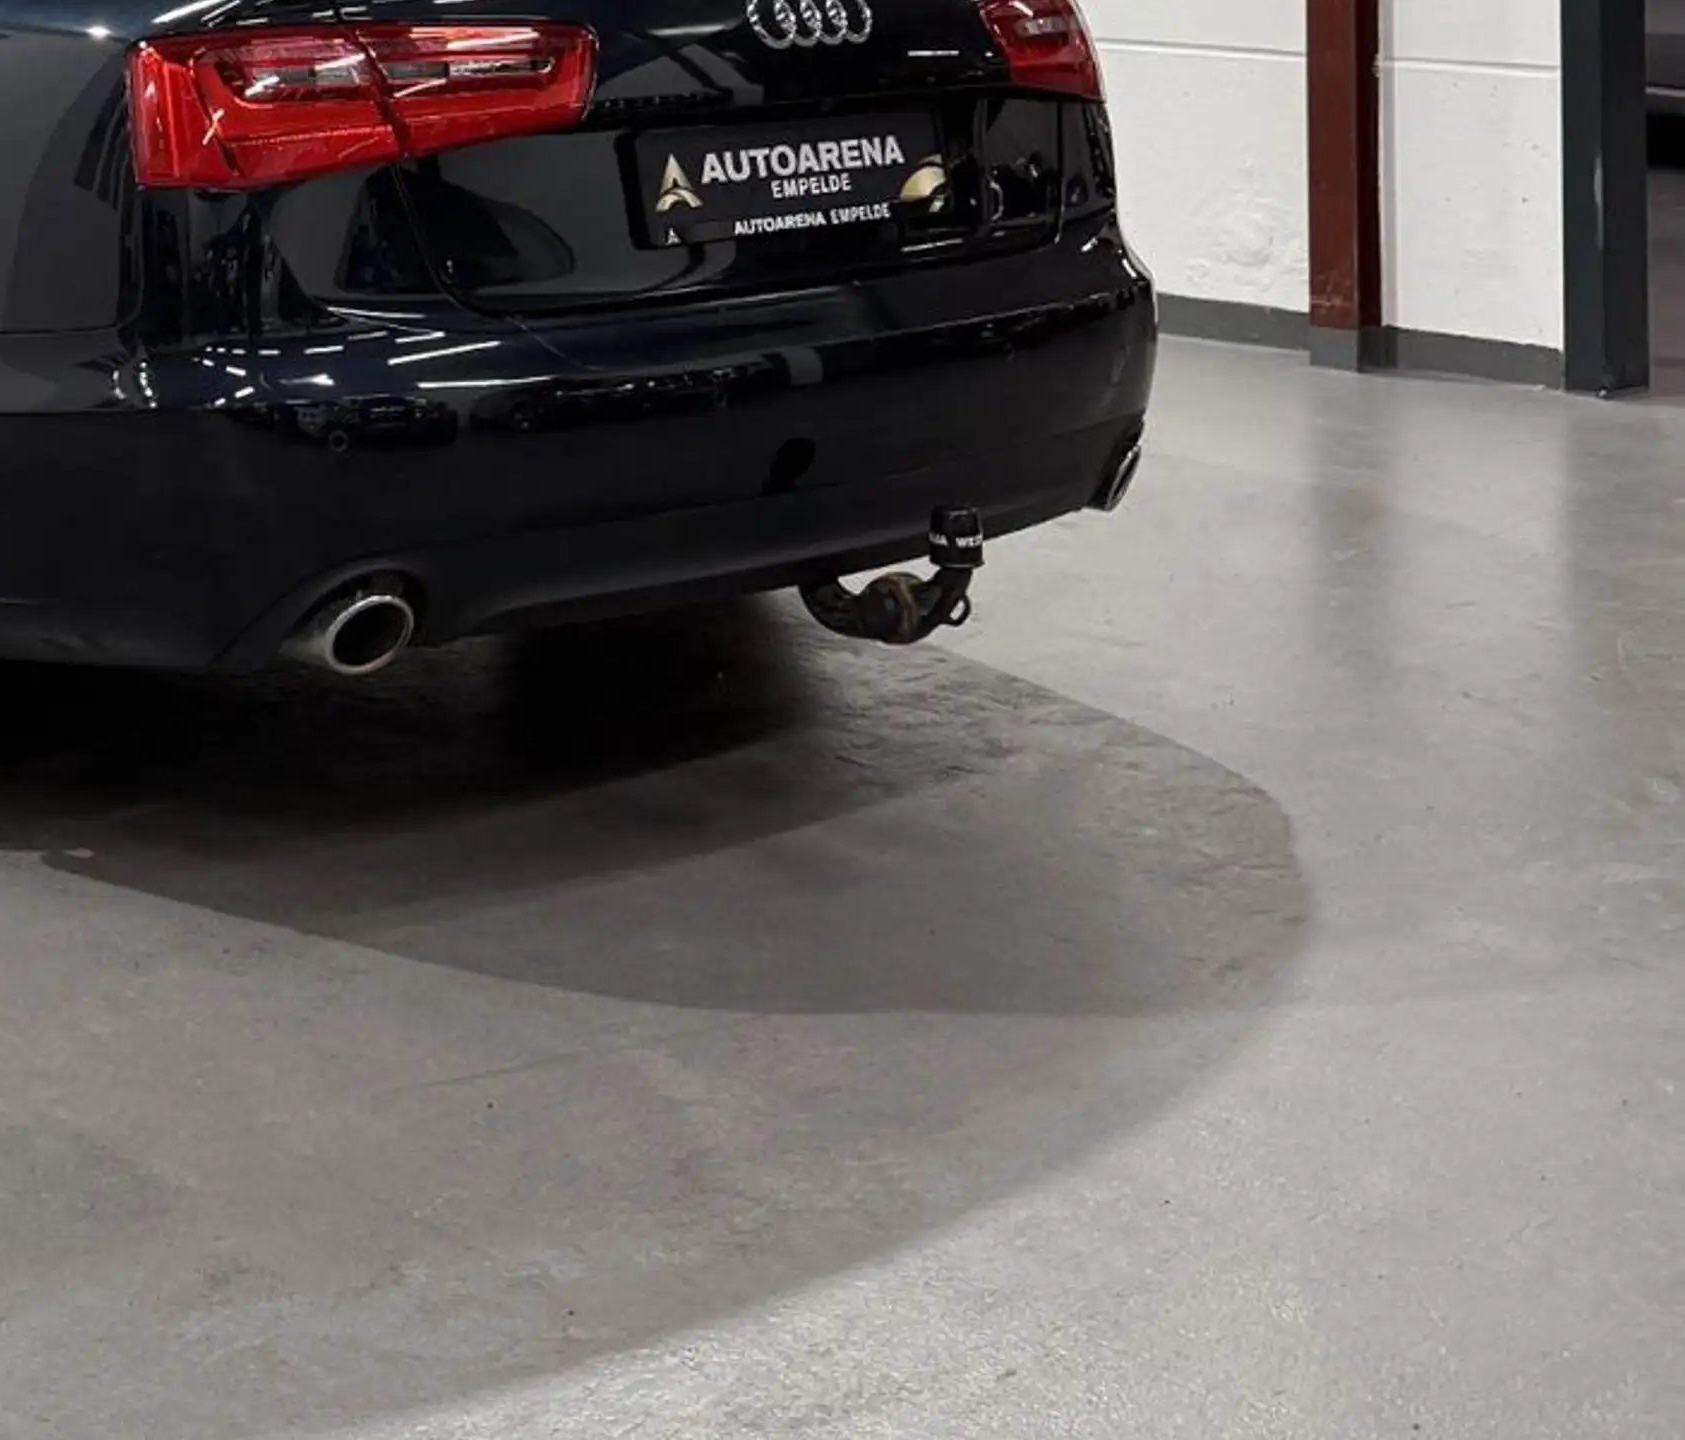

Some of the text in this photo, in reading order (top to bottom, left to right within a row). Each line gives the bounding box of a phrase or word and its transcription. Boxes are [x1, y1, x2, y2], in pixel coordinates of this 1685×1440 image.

[701, 135, 905, 184] AUTOARENA
[771, 173, 852, 199] EMPELDE
[734, 203, 891, 235] AUTOARENA EMPELDE
